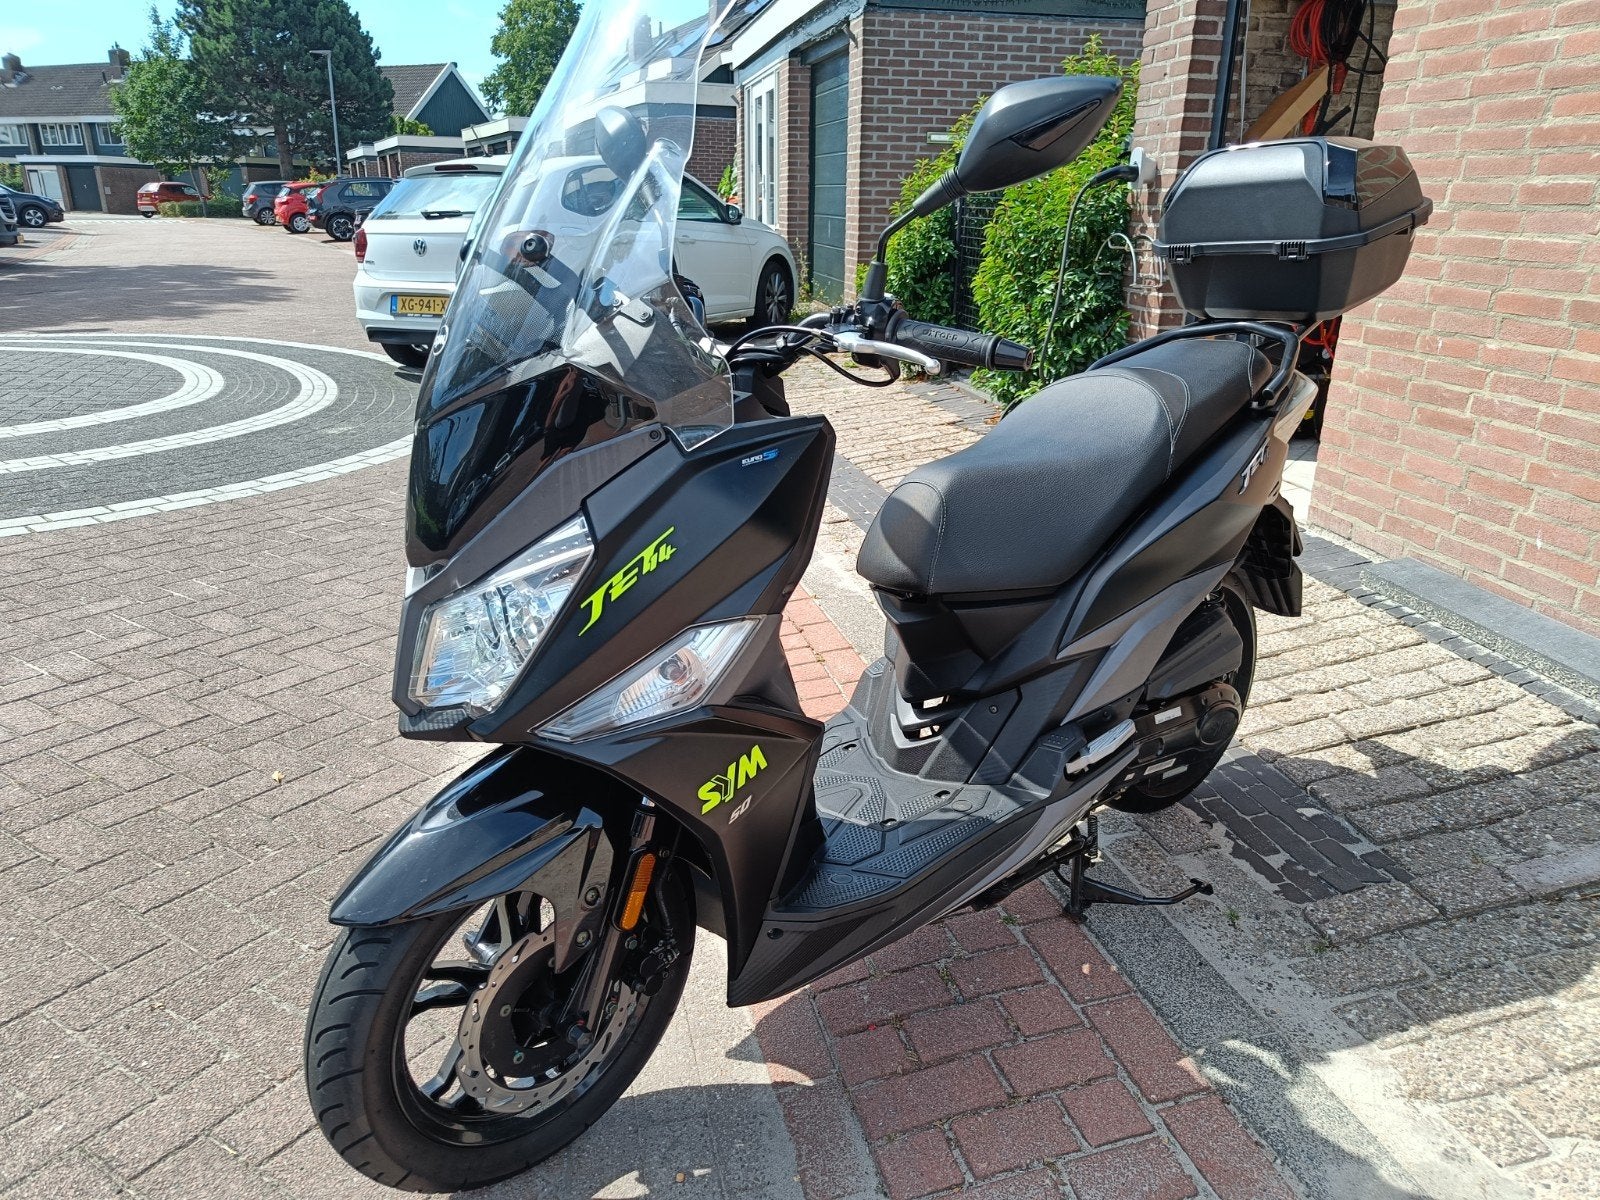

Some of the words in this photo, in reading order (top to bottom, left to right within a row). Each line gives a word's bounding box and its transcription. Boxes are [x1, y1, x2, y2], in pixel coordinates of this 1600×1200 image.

[400, 298, 447, 312] XG-941-X
[697, 744, 768, 815] SYM
[728, 794, 753, 825] 50
